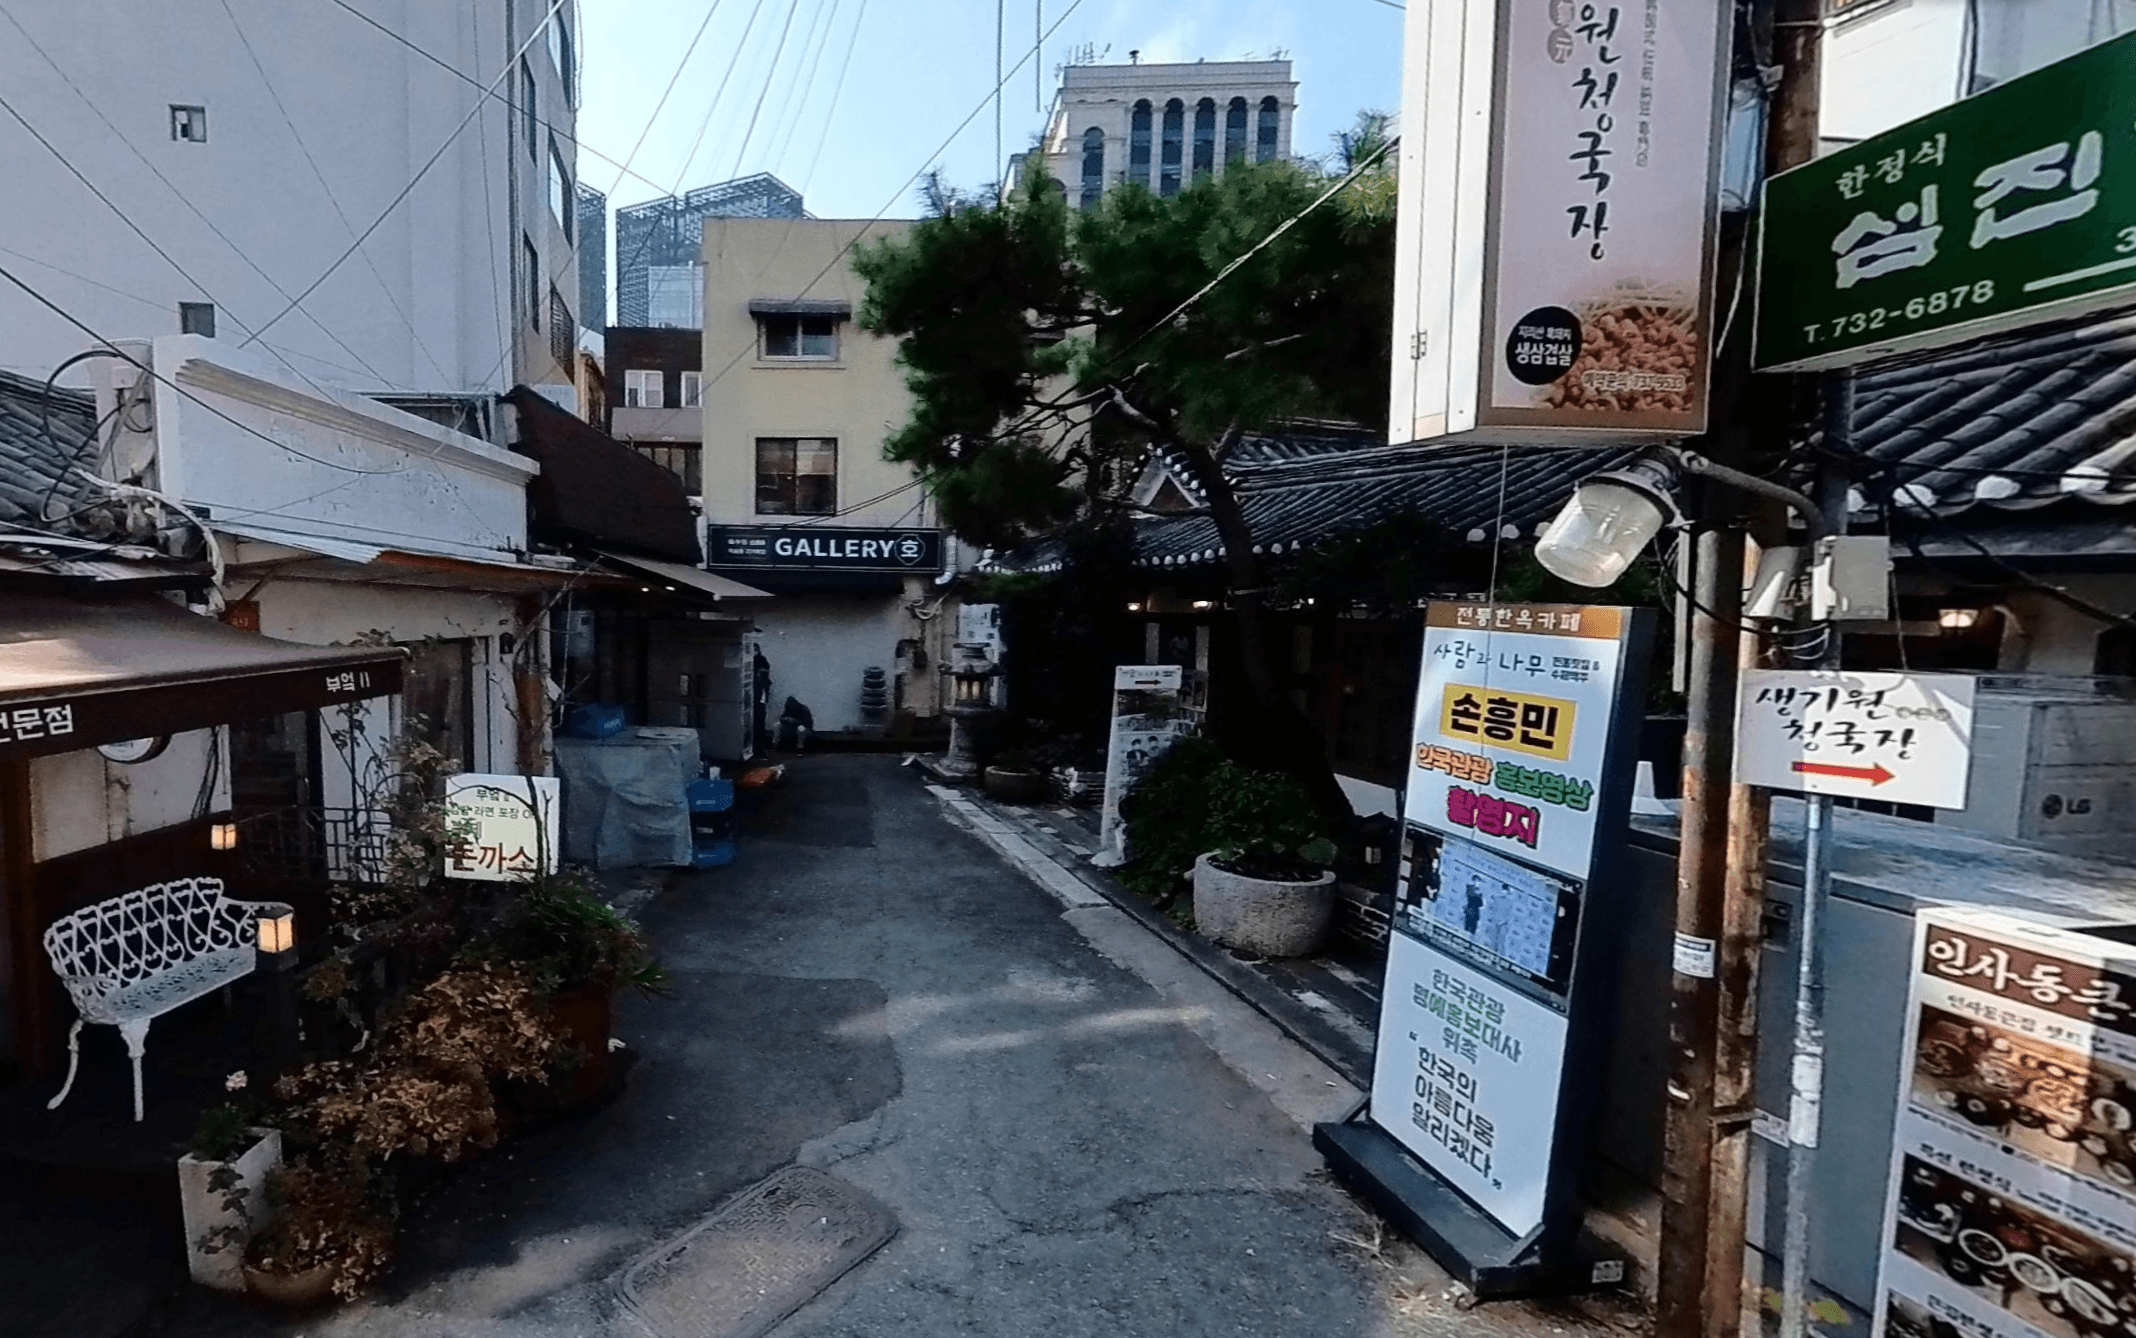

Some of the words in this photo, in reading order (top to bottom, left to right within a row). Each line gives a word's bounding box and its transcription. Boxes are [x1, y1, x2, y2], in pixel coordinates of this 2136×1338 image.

[1835, 132, 1948, 200] 한정식
[1803, 279, 1996, 344] T.732-6878
[1515, 342, 1573, 366] 생삼겹살
[774, 538, 895, 558] GALLERY
[1457, 606, 1582, 632] 전통한옥카페
[325, 671, 356, 693] 부엌
[1755, 687, 1889, 720] 생기원
[1450, 693, 1559, 750] 손흥민
[1780, 719, 1917, 761] 청국장
[1416, 742, 1493, 785] 한국관광
[1495, 761, 1595, 812] 홍보영상
[475, 805, 495, 818] 라면
[1432, 968, 1506, 1026] 한국관광
[1928, 937, 2136, 1020] 인사동큰
[1412, 981, 1523, 1064] 명예홍보대사
[1414, 1074, 1495, 1149] 아름다움
